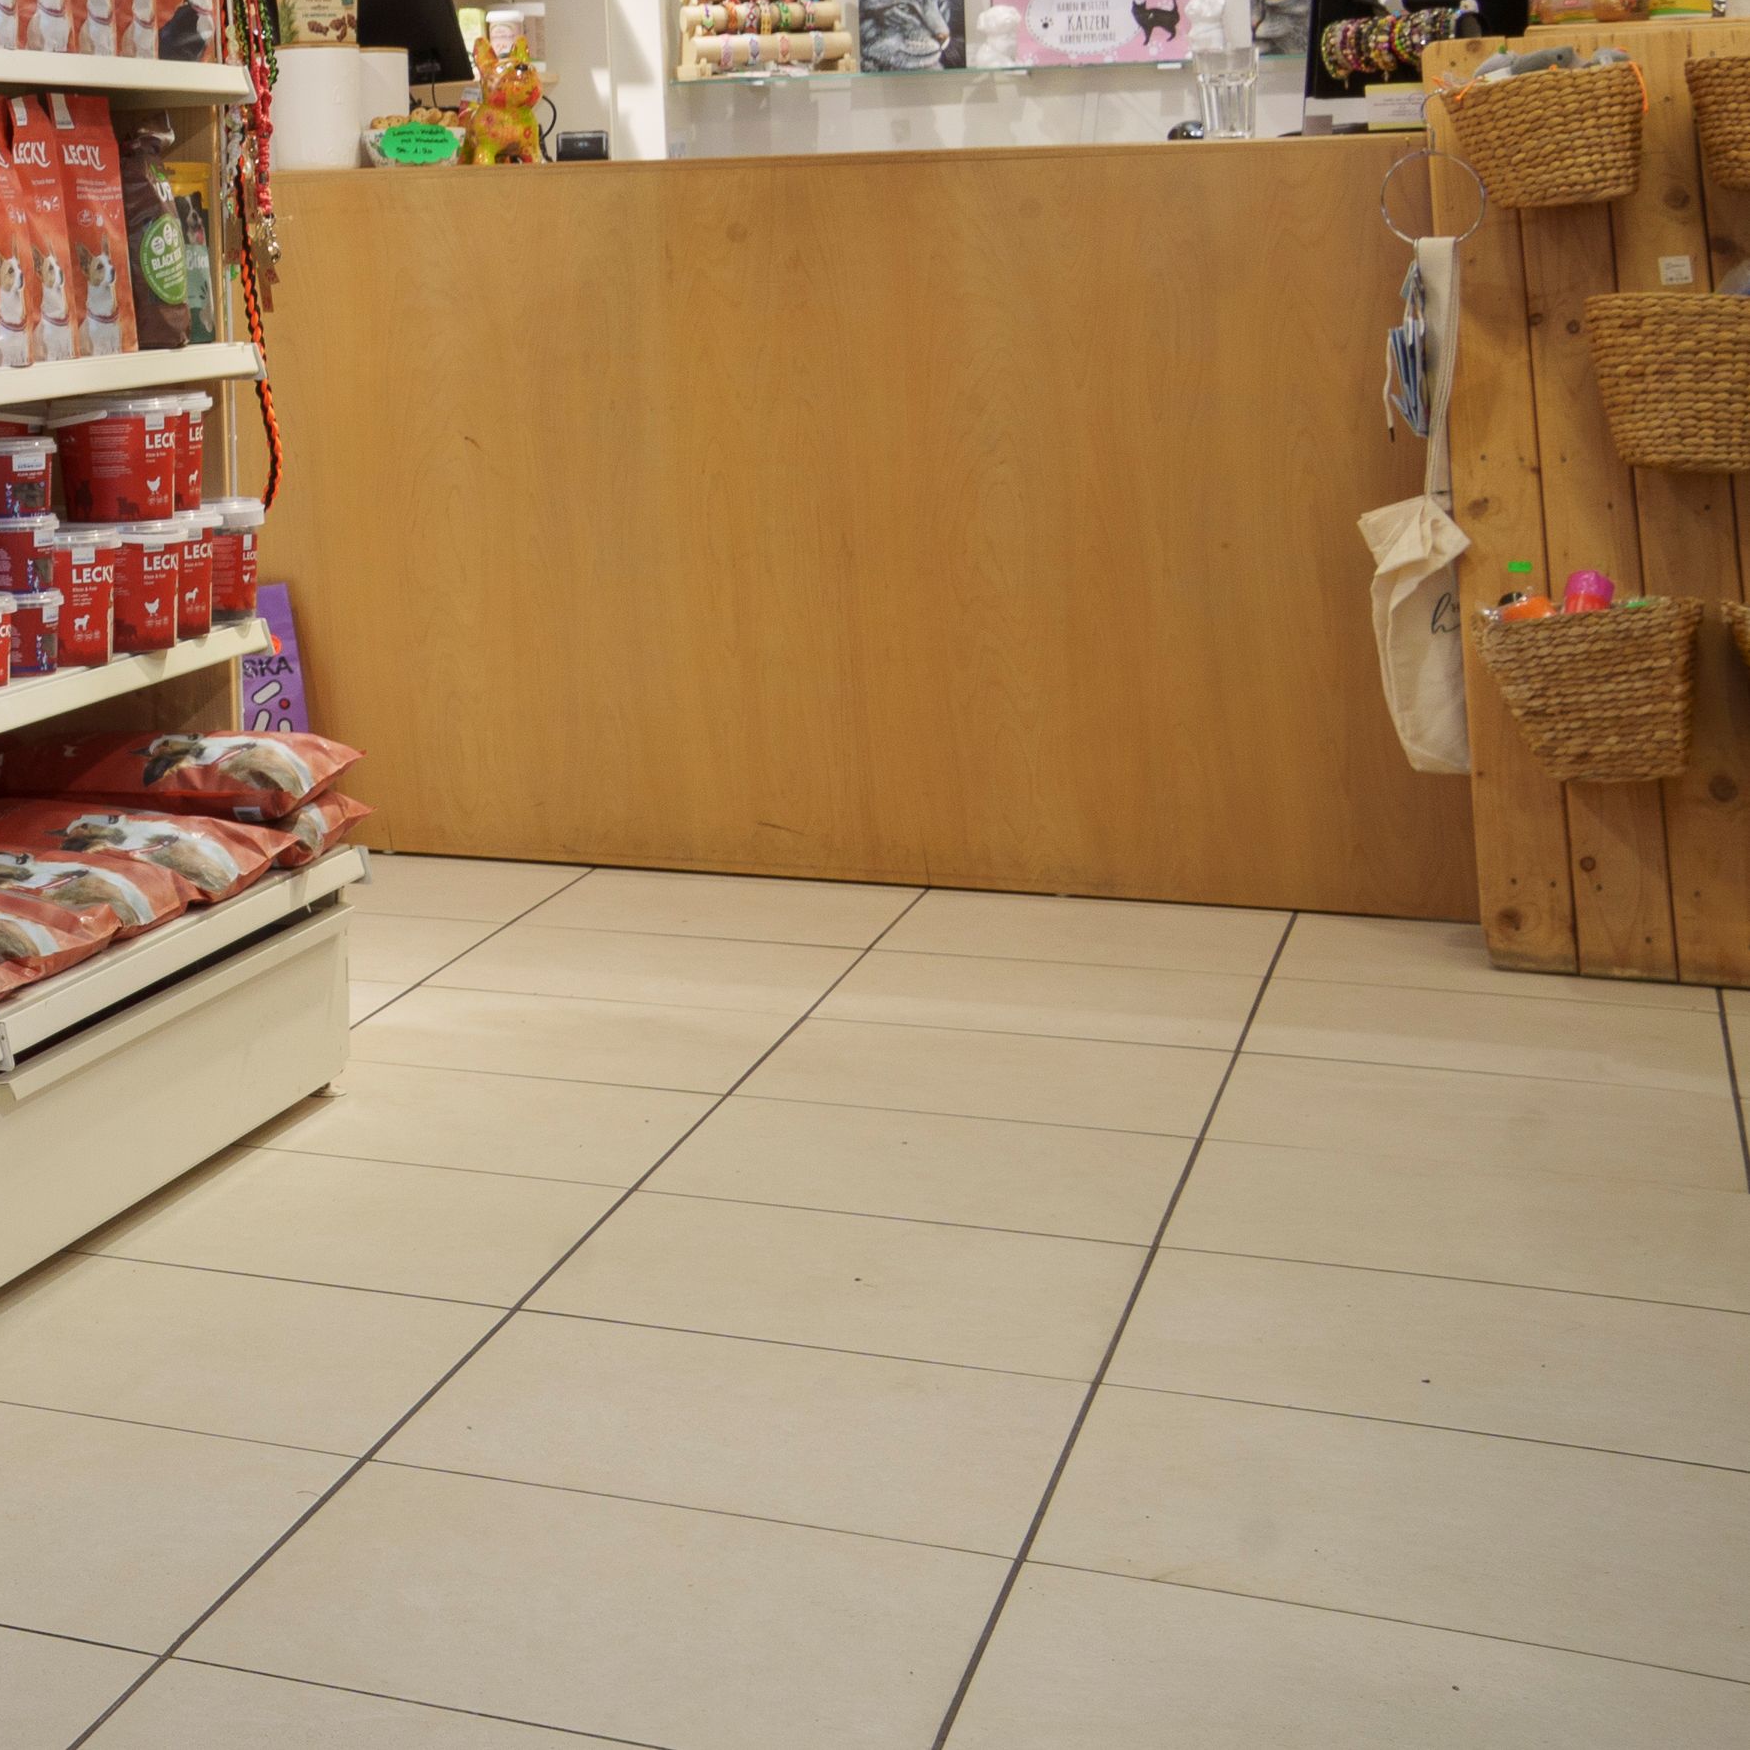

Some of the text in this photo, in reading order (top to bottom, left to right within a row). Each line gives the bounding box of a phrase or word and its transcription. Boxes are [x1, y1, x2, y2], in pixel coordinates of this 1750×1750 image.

[1068, 15, 1109, 30] KATZEN
[13, 141, 52, 172] LECKY
[63, 142, 107, 173] LECKY
[71, 564, 115, 585] LECKY
